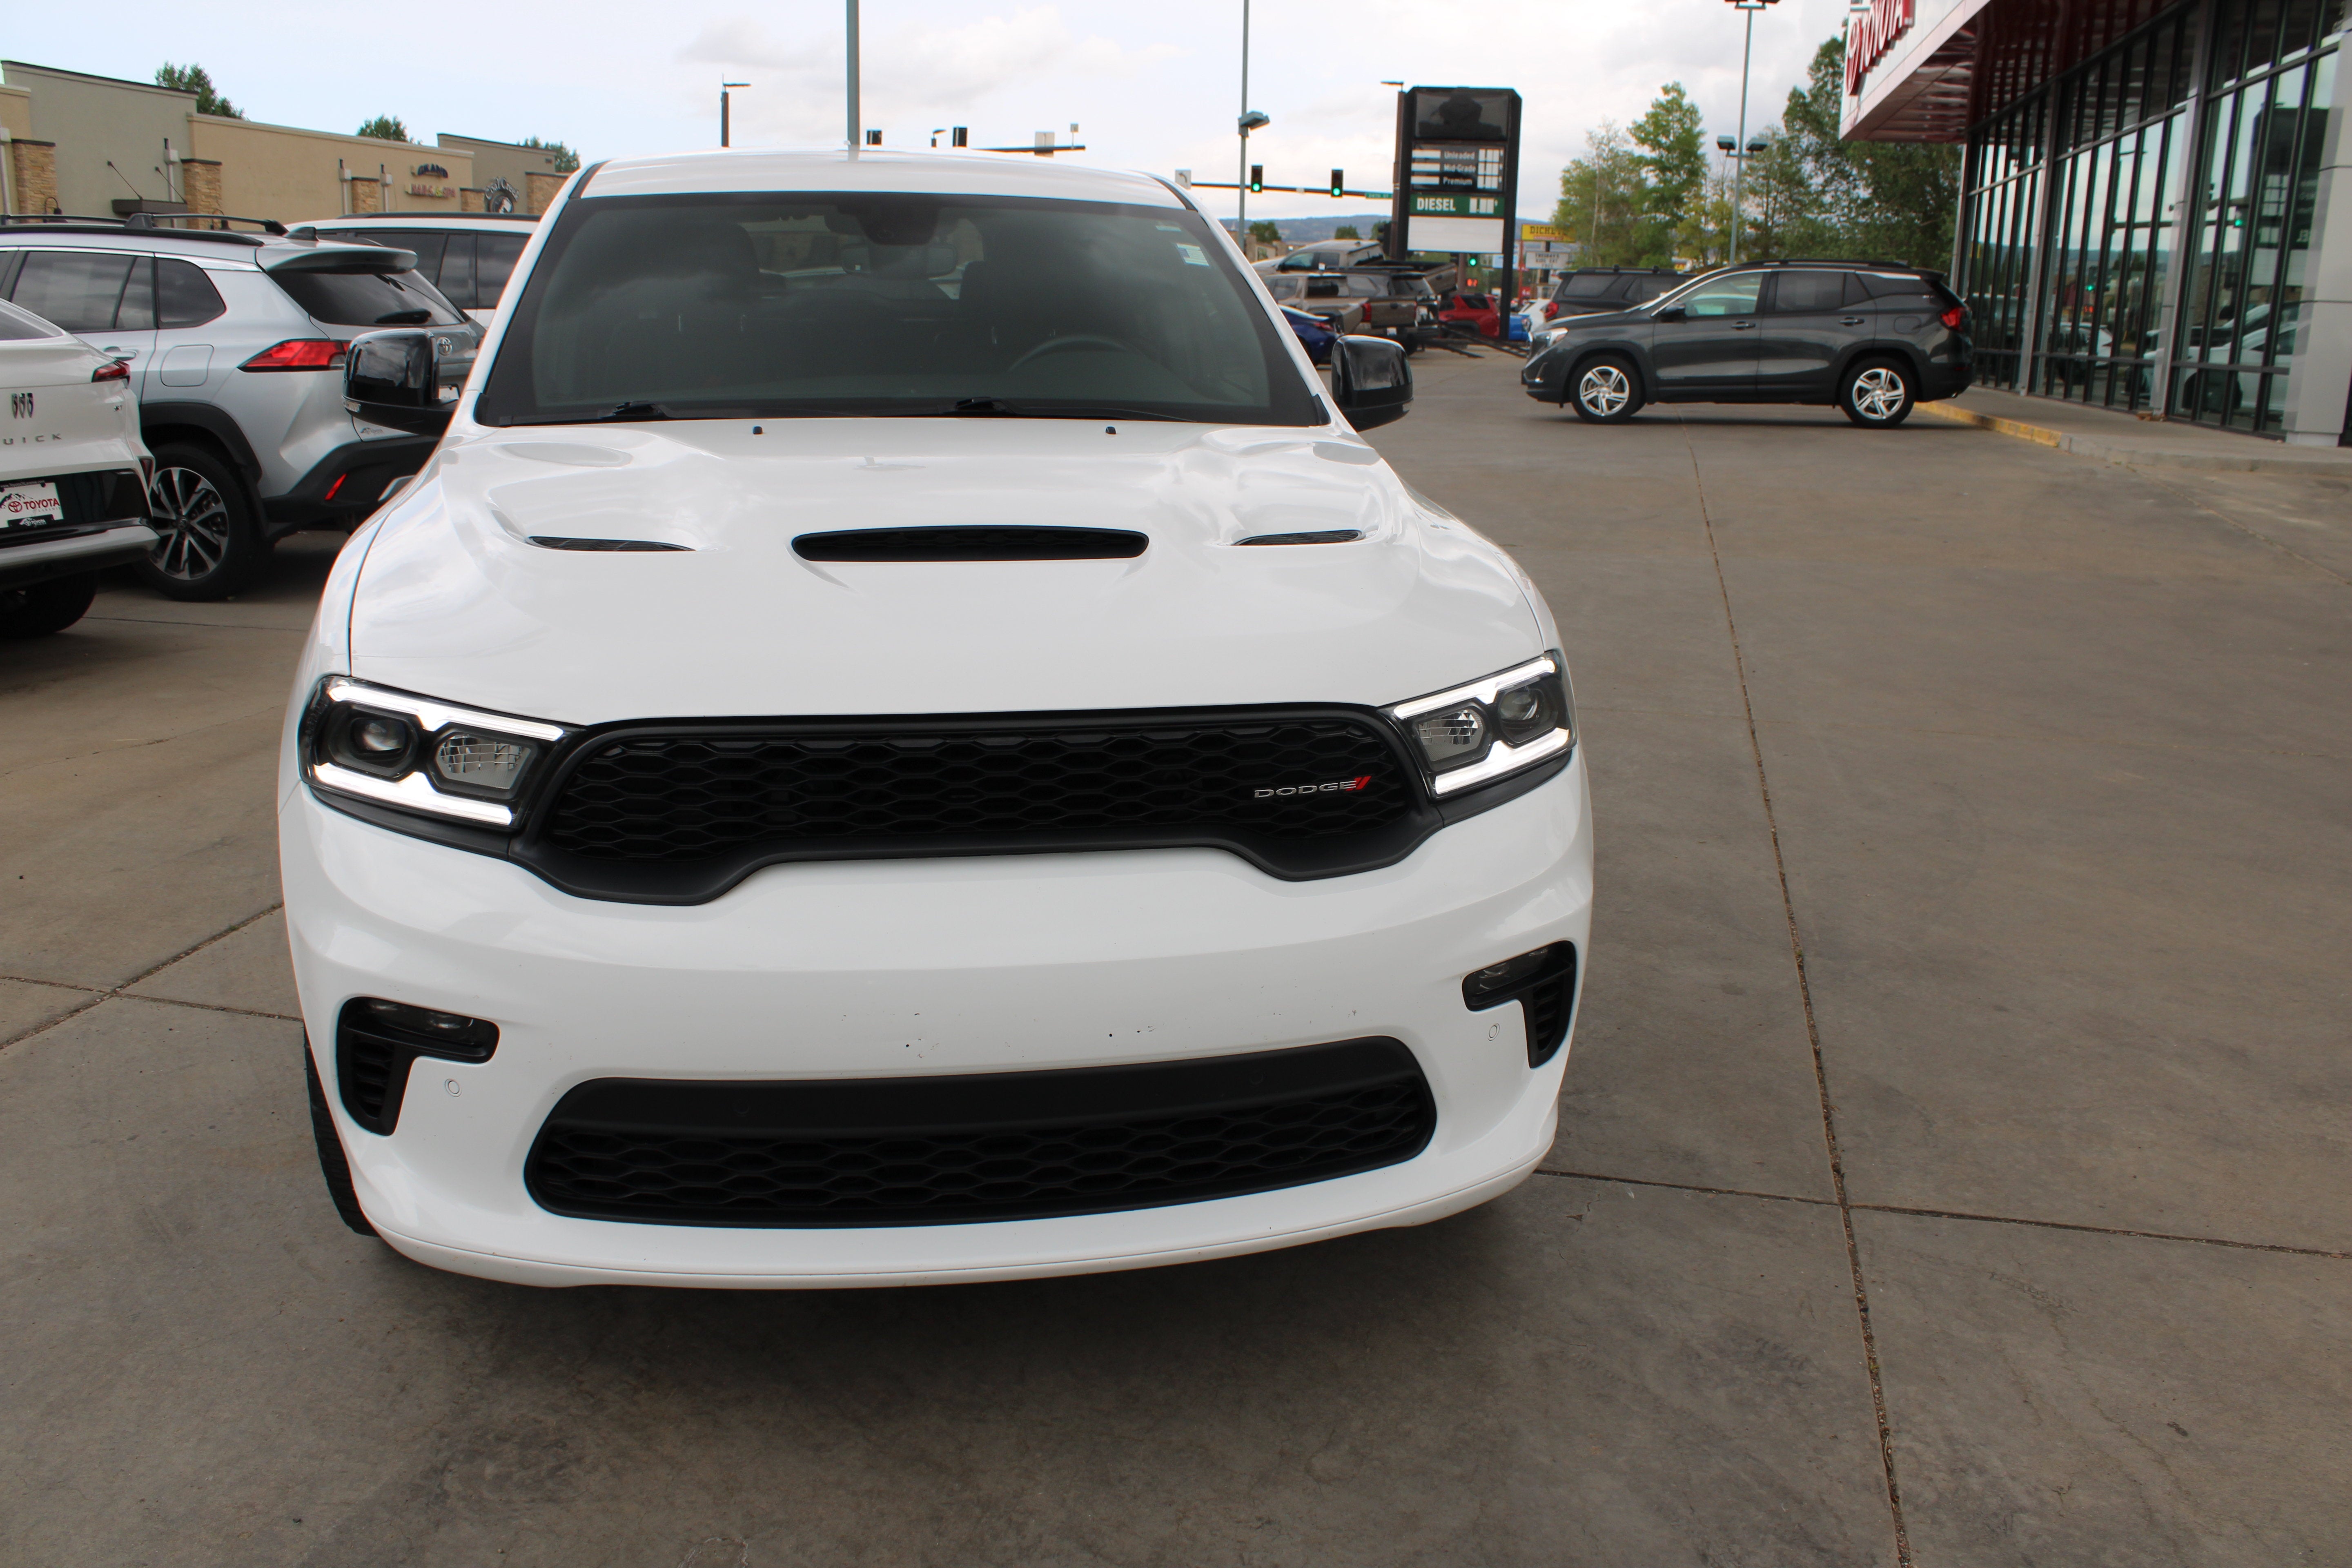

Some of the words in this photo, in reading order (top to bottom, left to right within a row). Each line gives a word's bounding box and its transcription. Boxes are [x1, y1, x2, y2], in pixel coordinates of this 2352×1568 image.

[1444, 151, 1475, 160] Unleaded
[417, 163, 448, 178] GRAND
[1443, 163, 1477, 173] Mid-Grade
[1443, 176, 1472, 185] Premium
[1417, 197, 1456, 212] DIESEL
[3, 434, 61, 445] UICK
[24, 498, 60, 510] TOYOTA
[1254, 780, 1357, 798] DODGE
